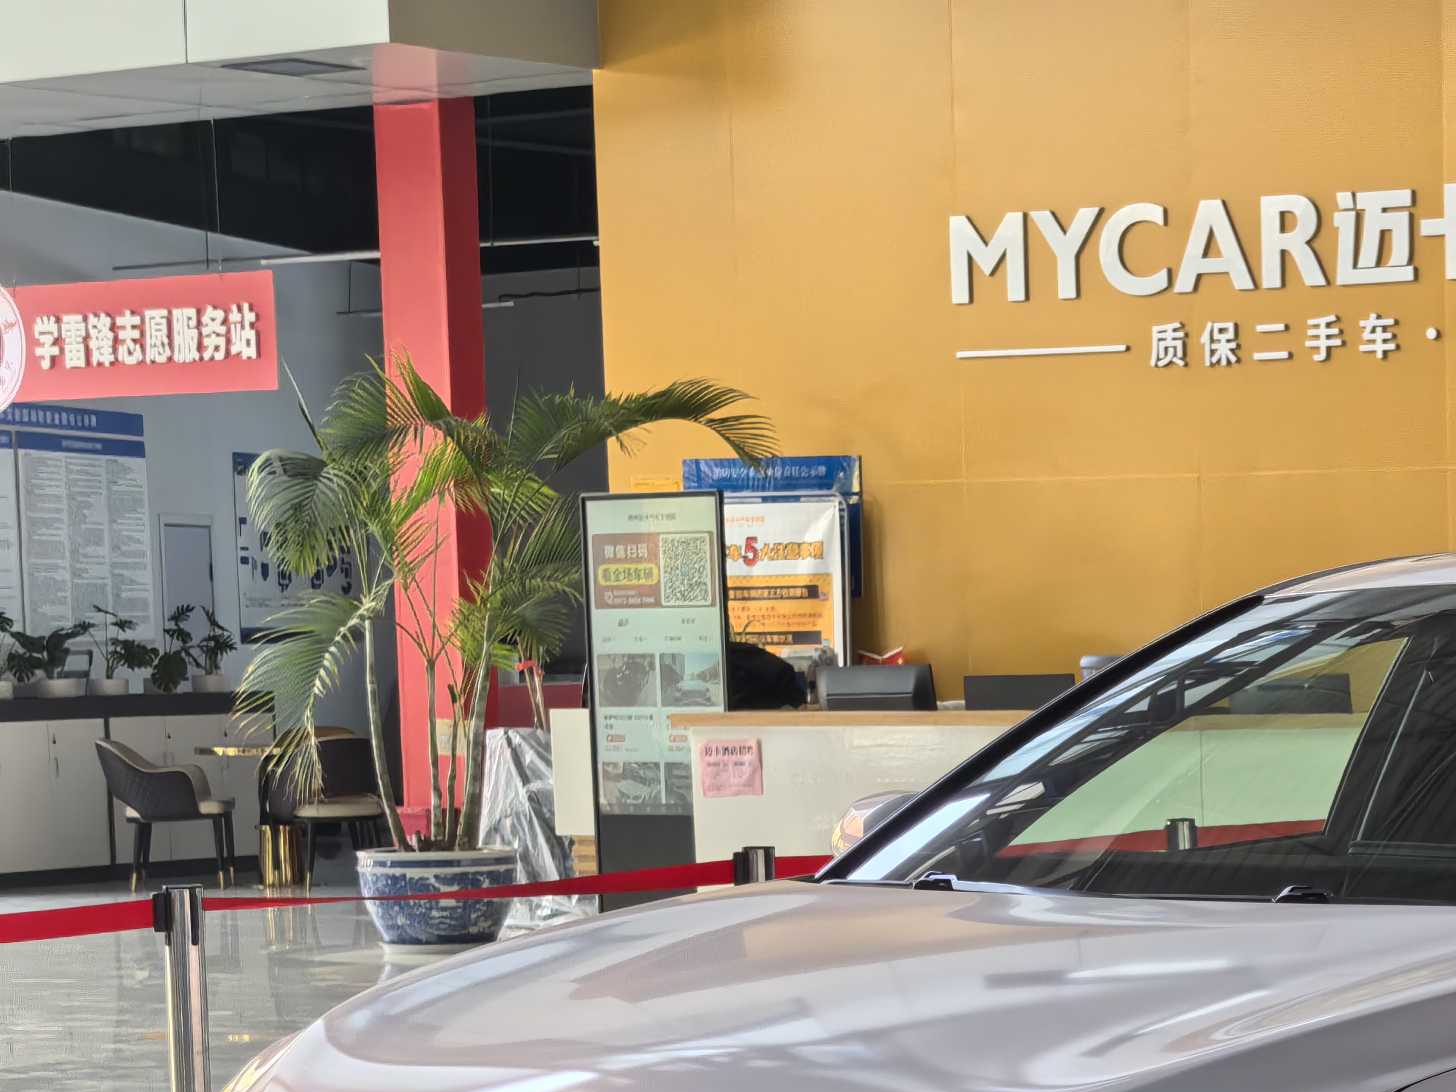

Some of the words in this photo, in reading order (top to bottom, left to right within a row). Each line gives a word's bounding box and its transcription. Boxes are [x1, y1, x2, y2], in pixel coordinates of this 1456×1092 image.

[34, 302, 258, 370] 学雷锋志愿服务站
